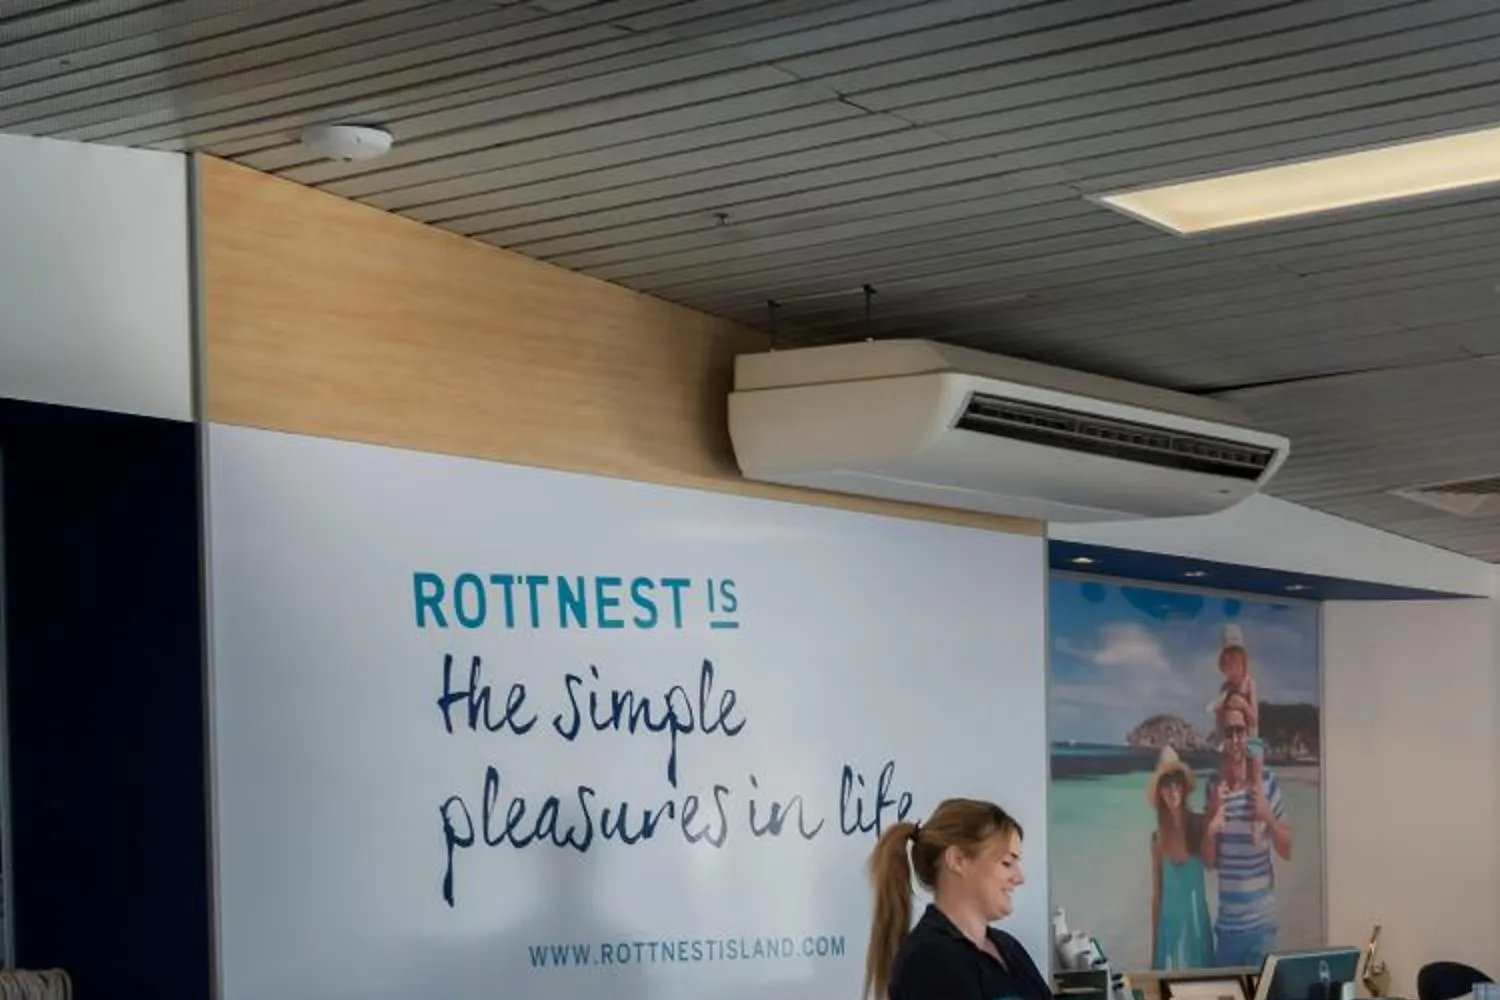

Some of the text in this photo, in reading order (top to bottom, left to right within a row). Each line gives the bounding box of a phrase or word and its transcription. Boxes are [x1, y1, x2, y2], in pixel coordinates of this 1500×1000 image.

[413, 572, 739, 629] ROTTNEST IS
[437, 653, 746, 789] the simple
[440, 765, 729, 907] pleasures
[748, 774, 825, 841] in
[529, 935, 846, 968] WWW.ROTTNESTISLAND.COM
